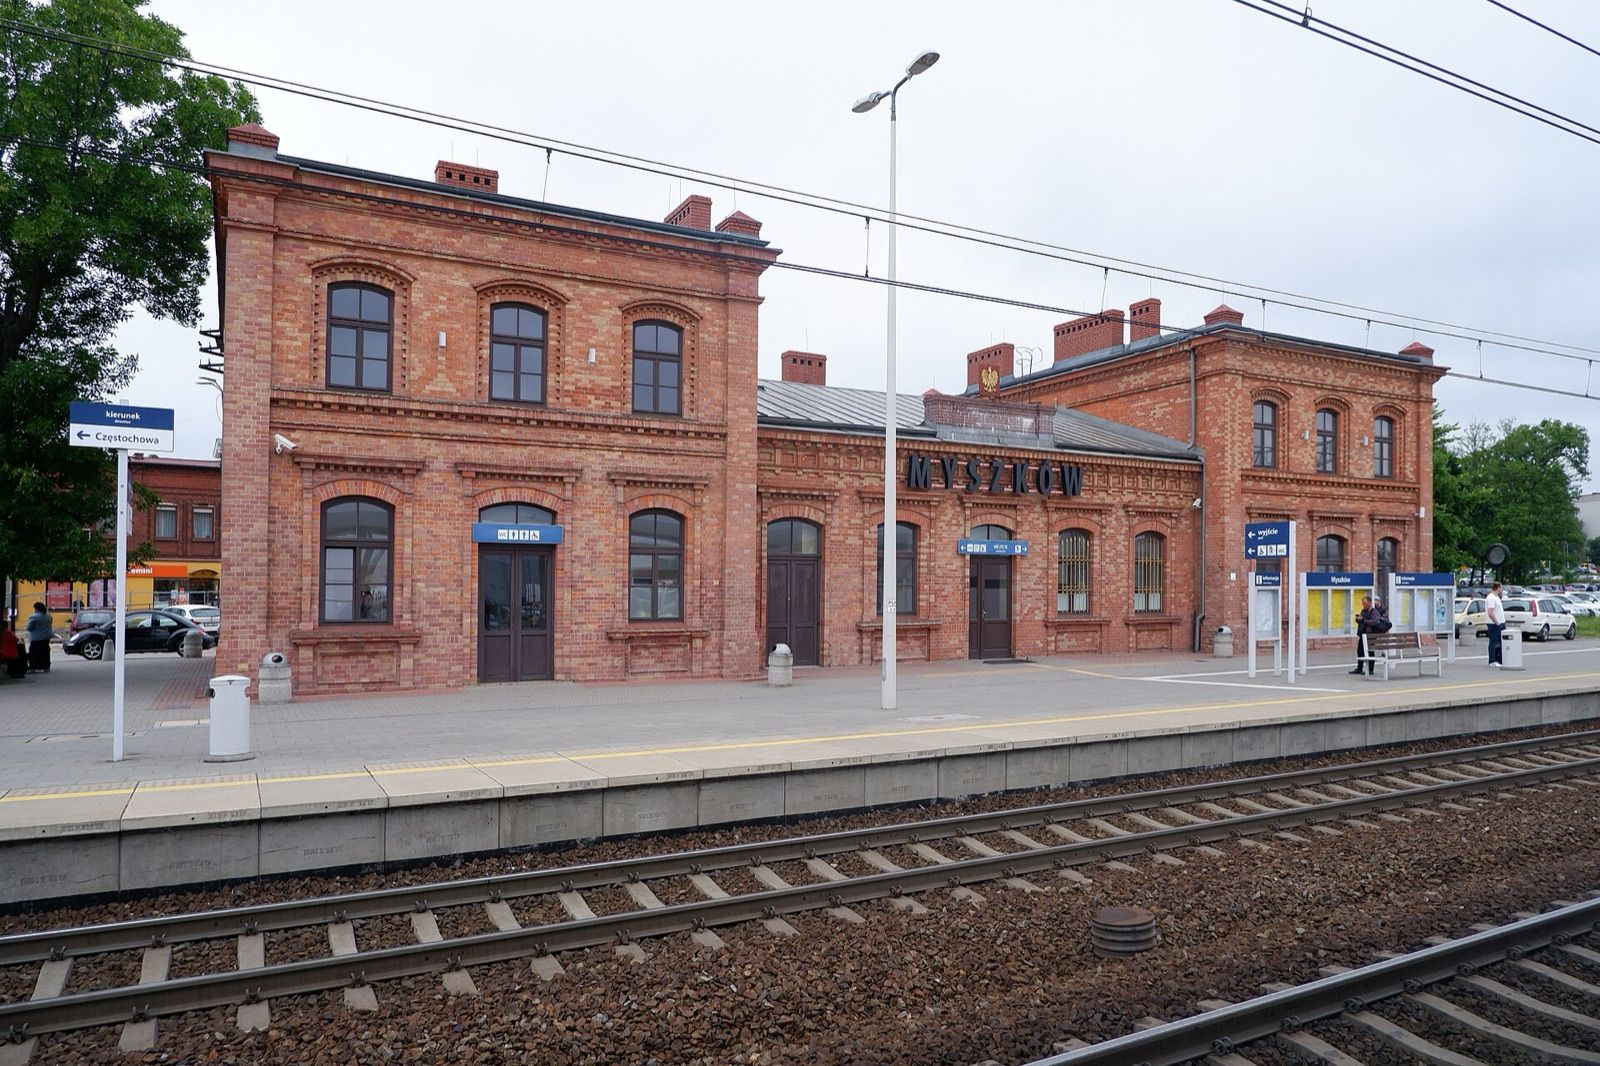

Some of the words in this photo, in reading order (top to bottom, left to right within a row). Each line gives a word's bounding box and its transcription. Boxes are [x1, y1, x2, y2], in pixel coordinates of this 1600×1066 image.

[105, 410, 140, 420] kierunek
[95, 432, 160, 444] Częstochowa
[907, 455, 1084, 497] MYSZKÓW
[1257, 528, 1279, 537] wyjście
